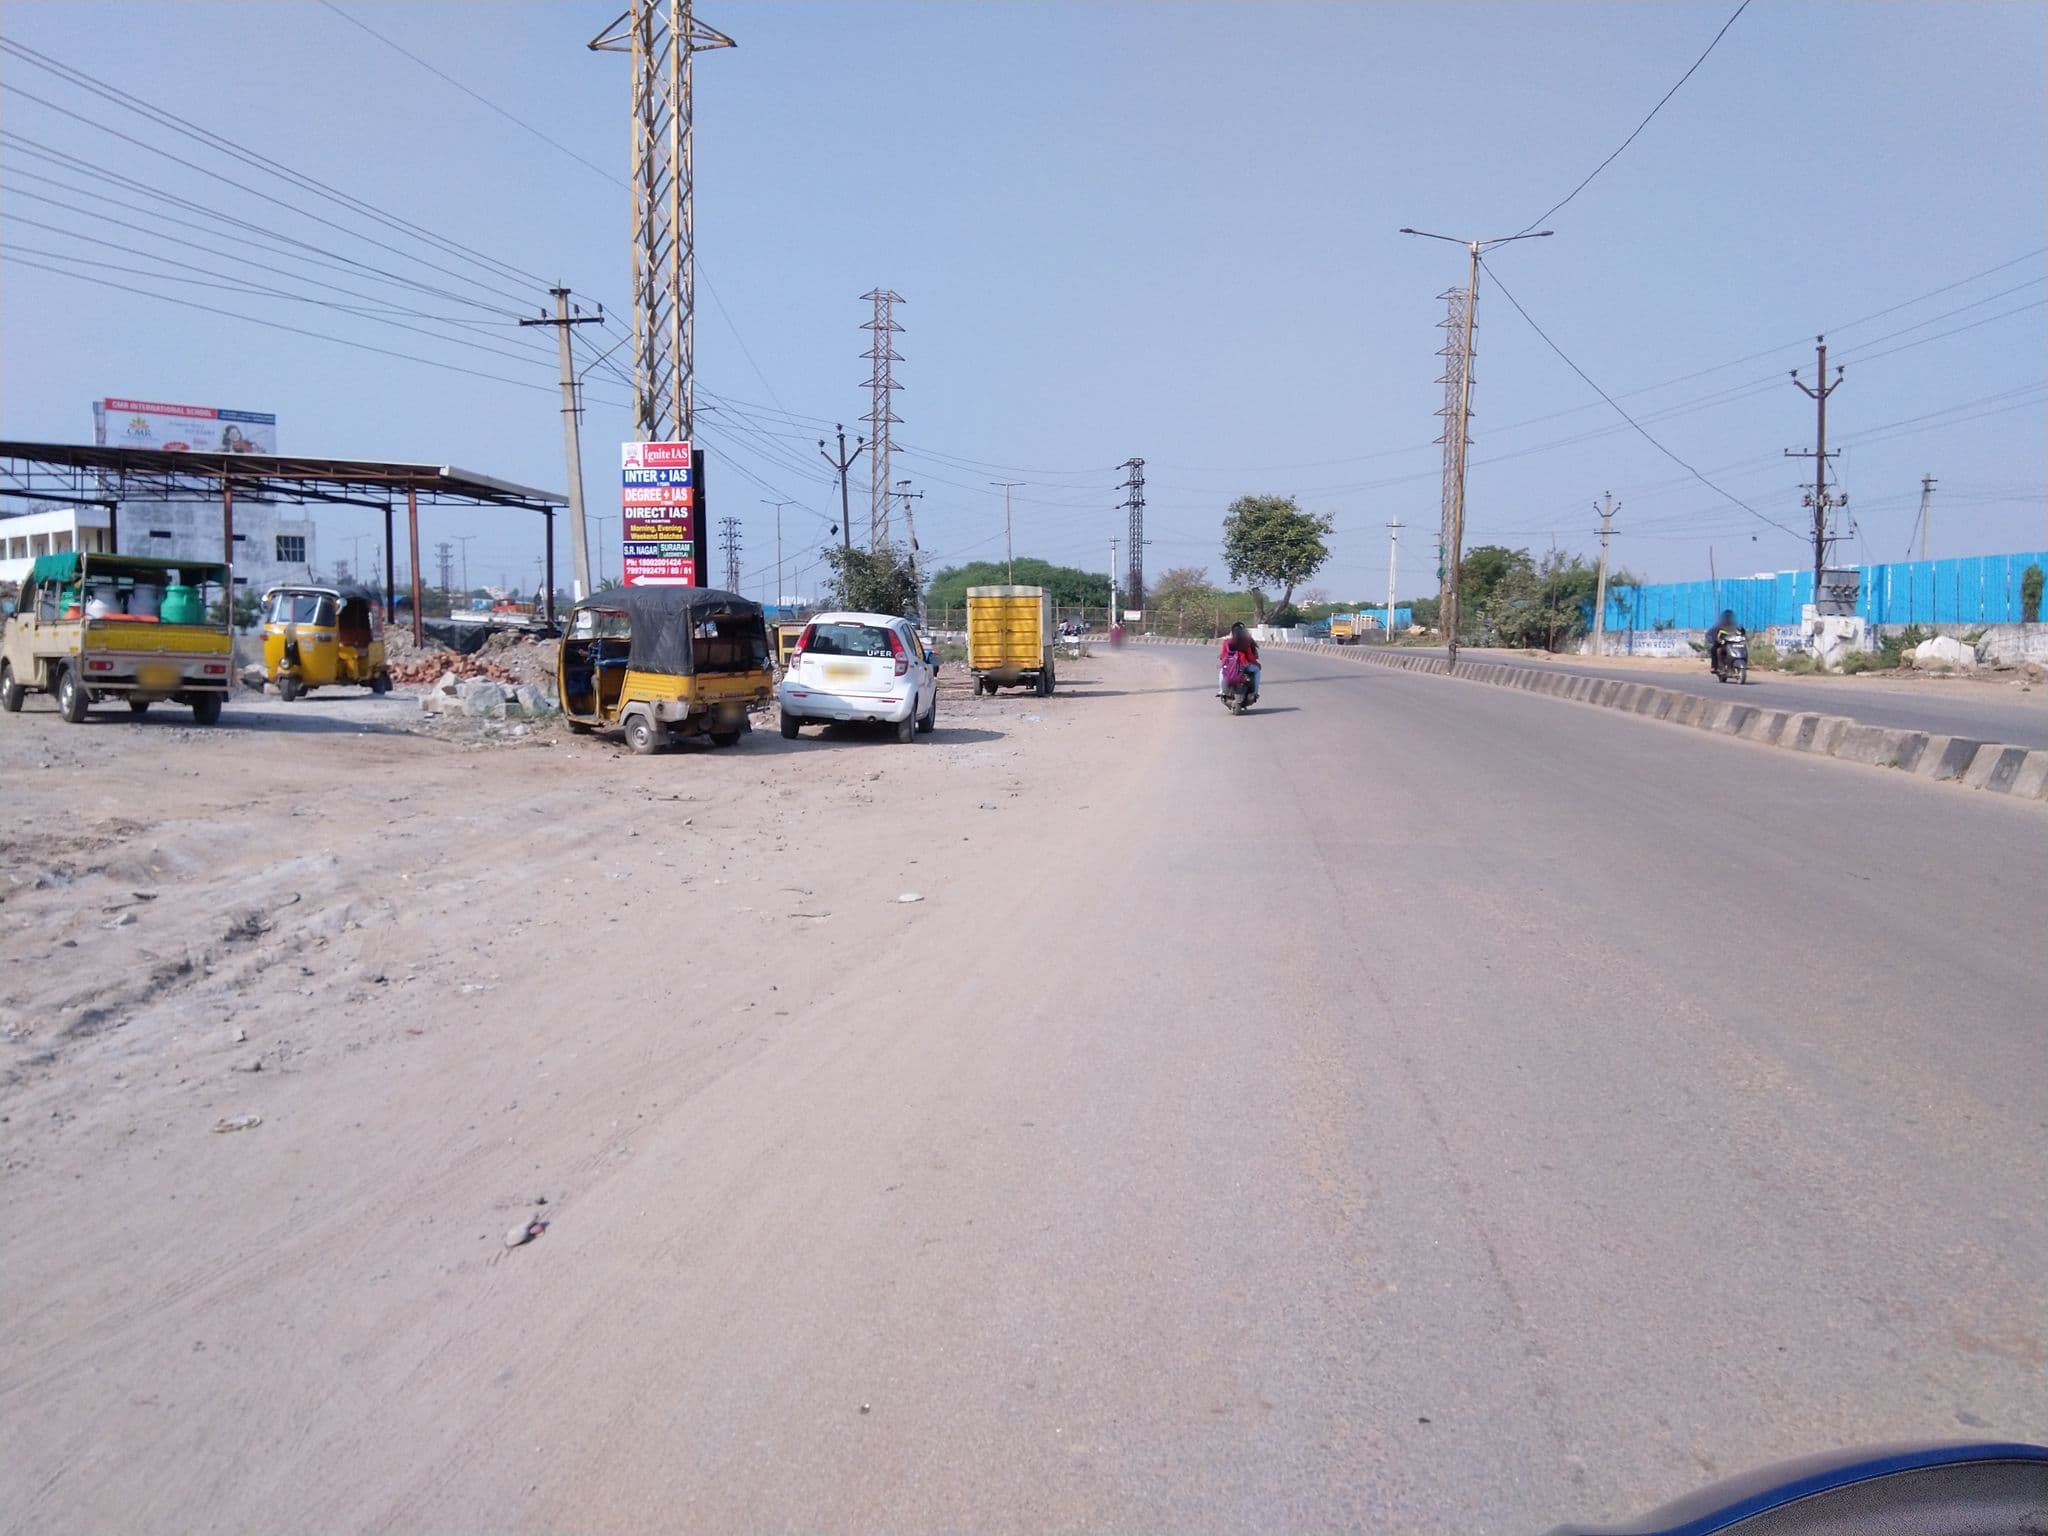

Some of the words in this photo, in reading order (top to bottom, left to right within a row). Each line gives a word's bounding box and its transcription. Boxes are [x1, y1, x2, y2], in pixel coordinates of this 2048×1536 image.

[130, 402, 185, 414] INTERNATIONAL
[186, 408, 212, 417] SCHOOL
[671, 448, 687, 459] IAS
[625, 470, 658, 482] INTER
[669, 470, 688, 482] IAS
[624, 488, 662, 501] DEGREE
[672, 488, 688, 501] IAS
[625, 507, 666, 518] DIRECT
[669, 507, 688, 518] IAS
[657, 525, 682, 533] Evening
[624, 546, 636, 555] S.R.
[636, 545, 658, 555] NAGAR
